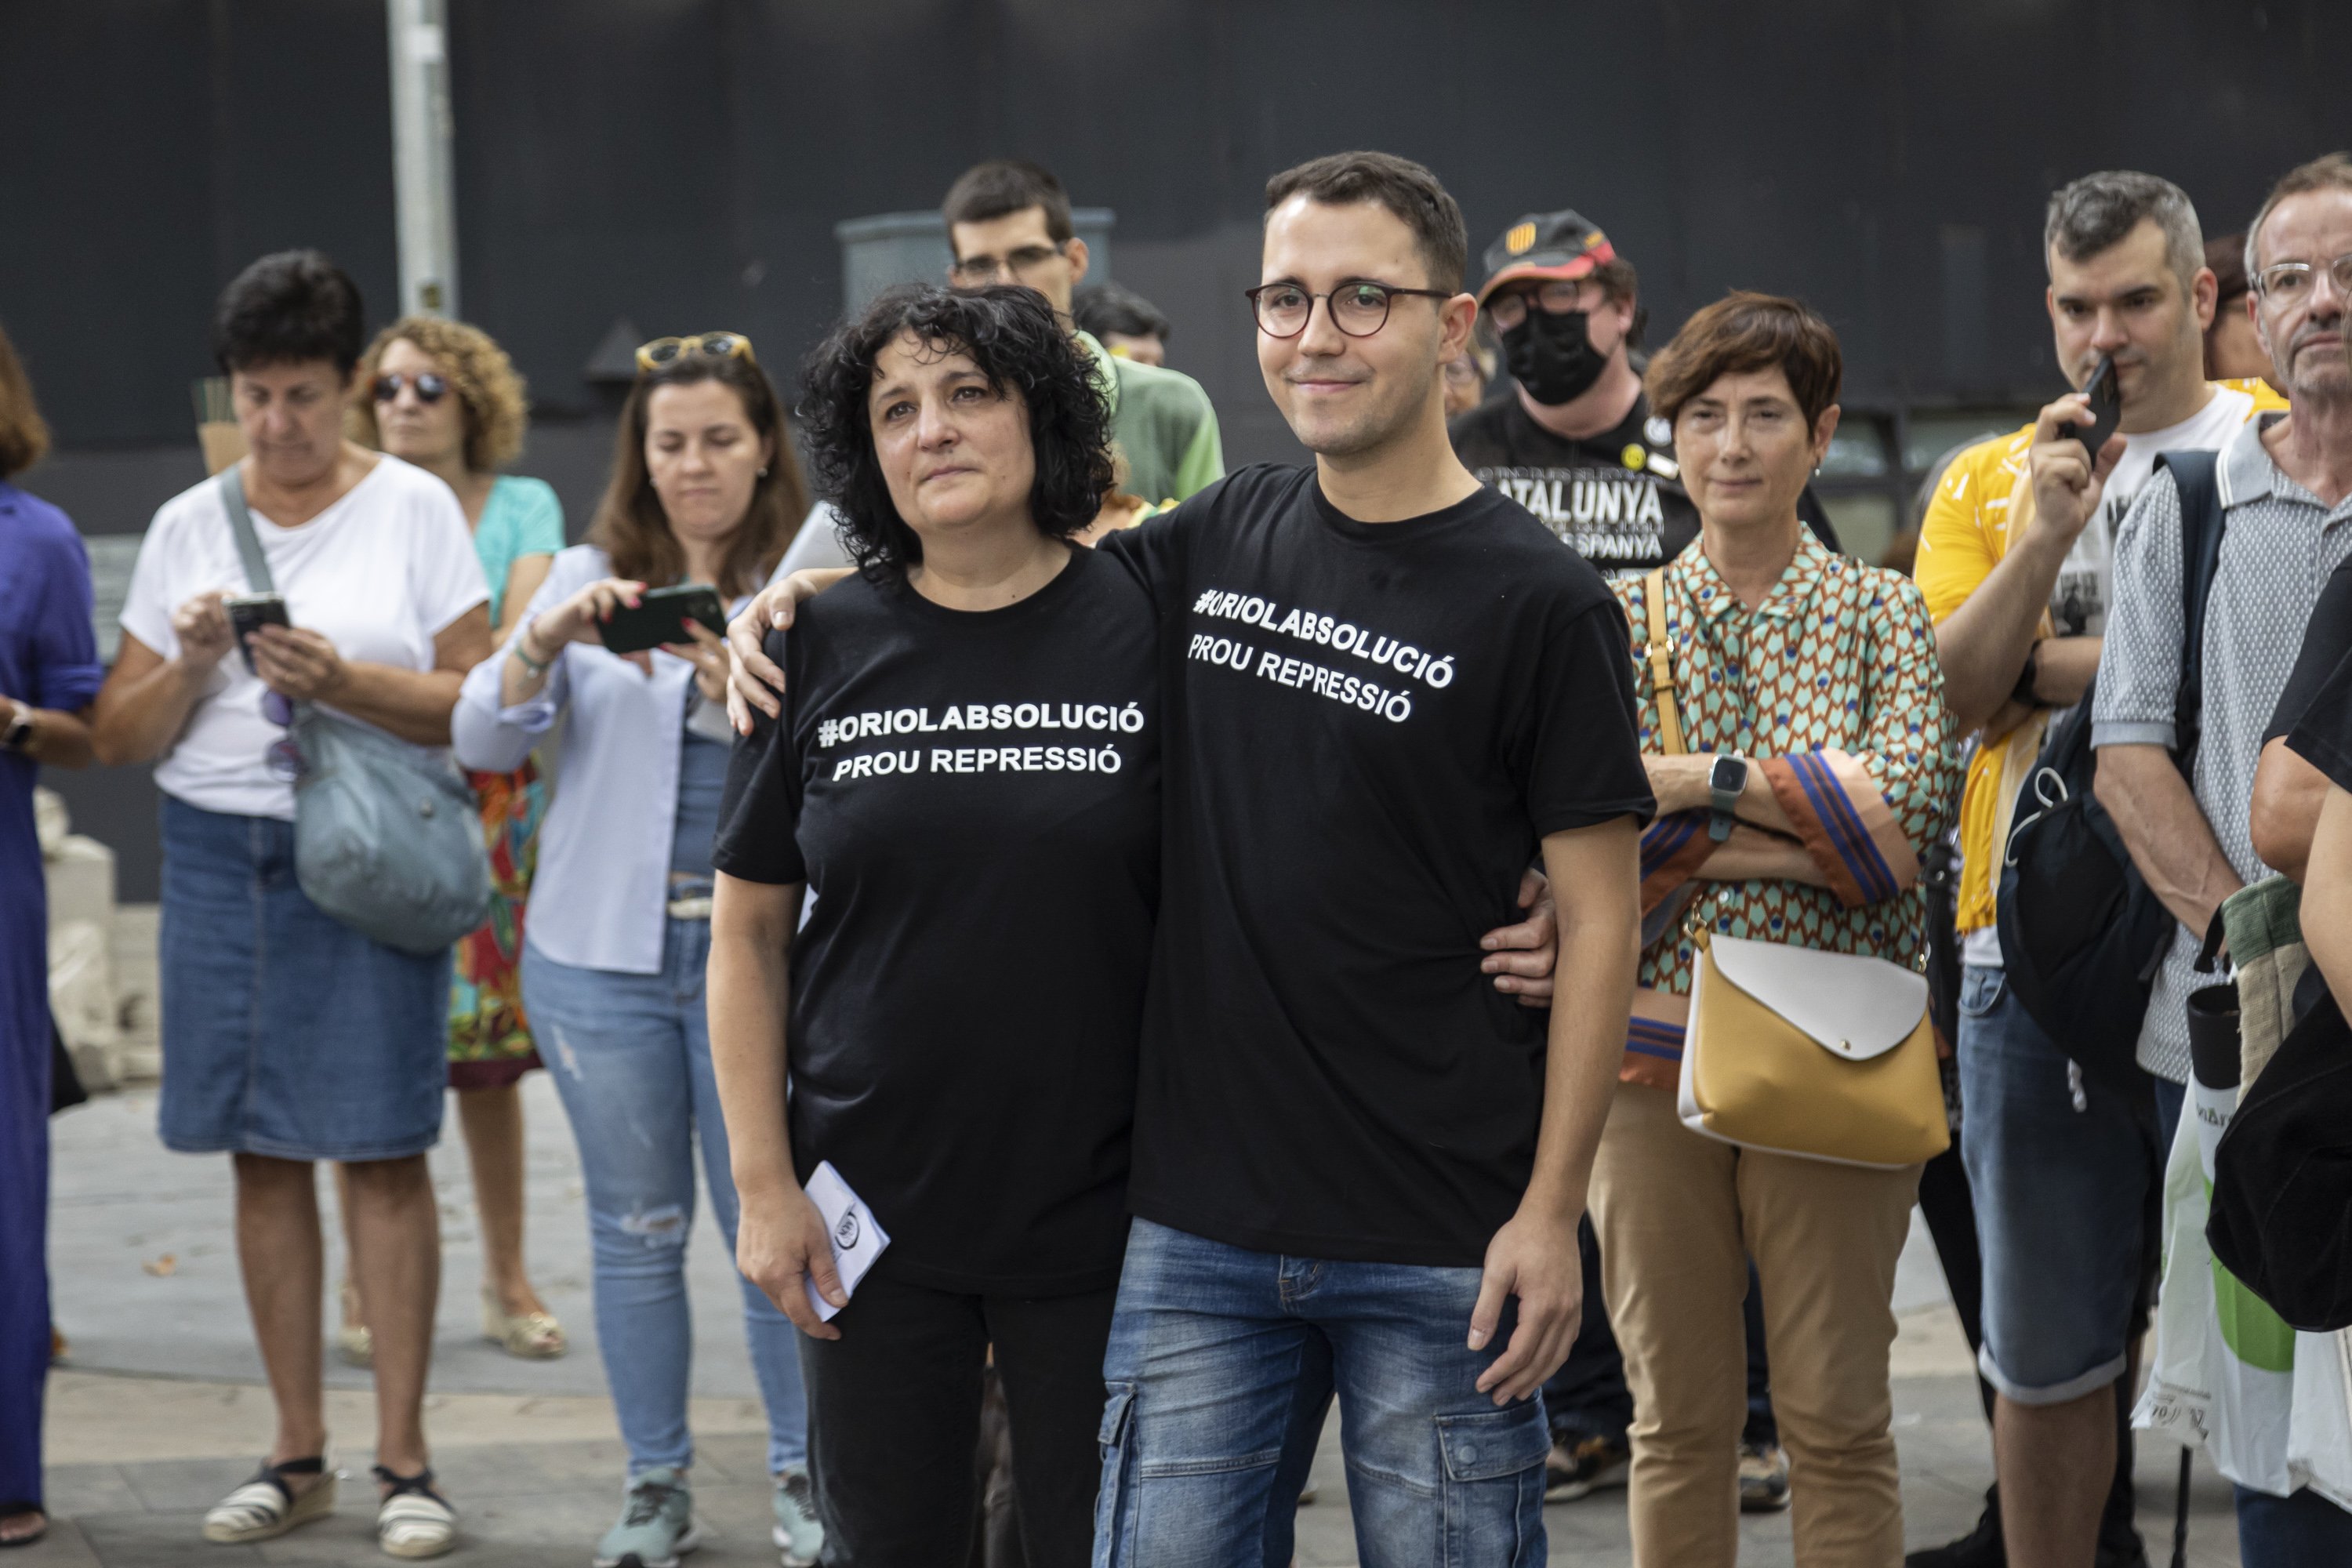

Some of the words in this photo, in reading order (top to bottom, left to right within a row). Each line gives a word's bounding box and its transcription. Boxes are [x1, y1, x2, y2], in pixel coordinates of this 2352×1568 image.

[1497, 479, 1664, 524] ATALUNYA
[1192, 589, 1455, 689] #ORIOLABSOLUCIÓ
[1187, 633, 1254, 671] PROU
[1256, 651, 1412, 723] REPRESSIÓ
[818, 701, 1145, 748] #ORIOLABSOLUCIÓ
[832, 750, 920, 782] PROU
[930, 743, 1122, 774] REPRESSIÓ
